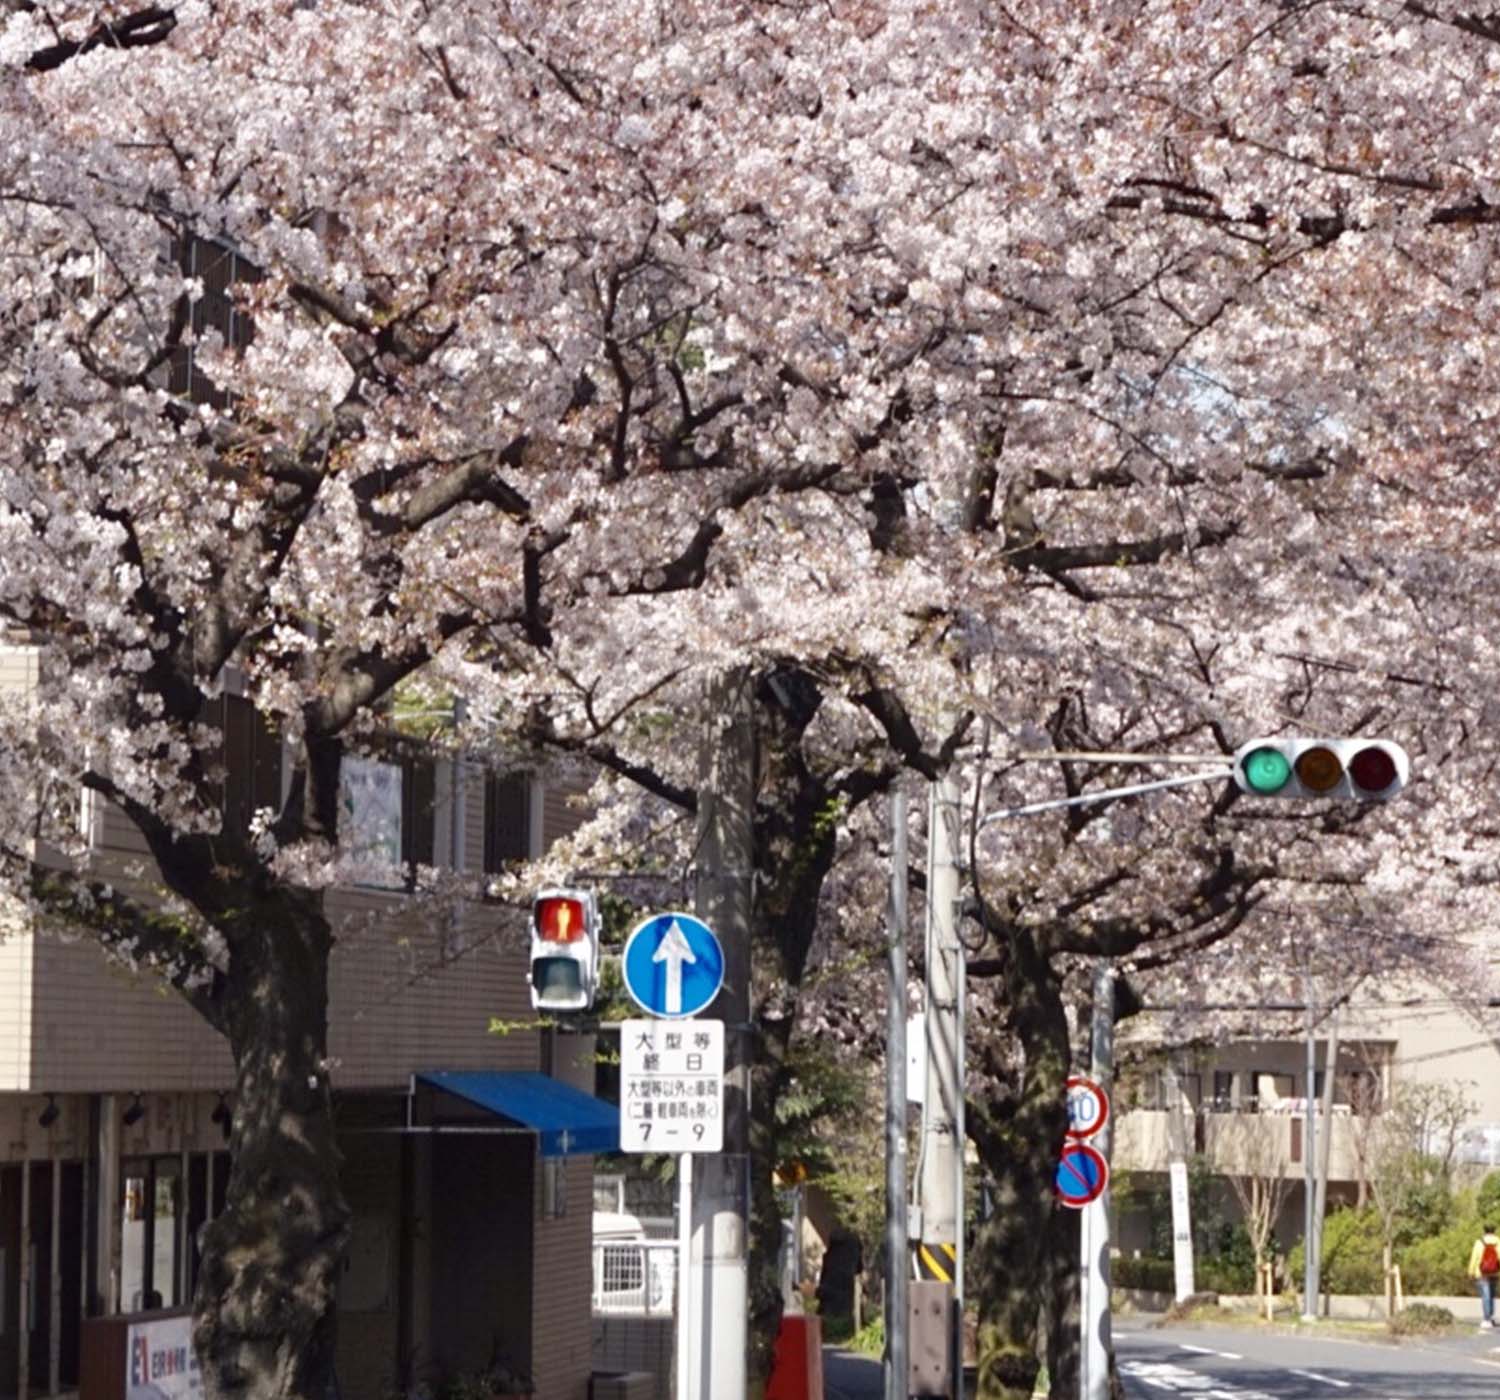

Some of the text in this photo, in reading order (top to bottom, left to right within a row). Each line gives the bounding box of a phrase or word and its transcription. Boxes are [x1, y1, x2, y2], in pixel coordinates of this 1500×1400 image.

[635, 1032, 710, 1050] 大型等
[643, 1053, 702, 1071] 終日
